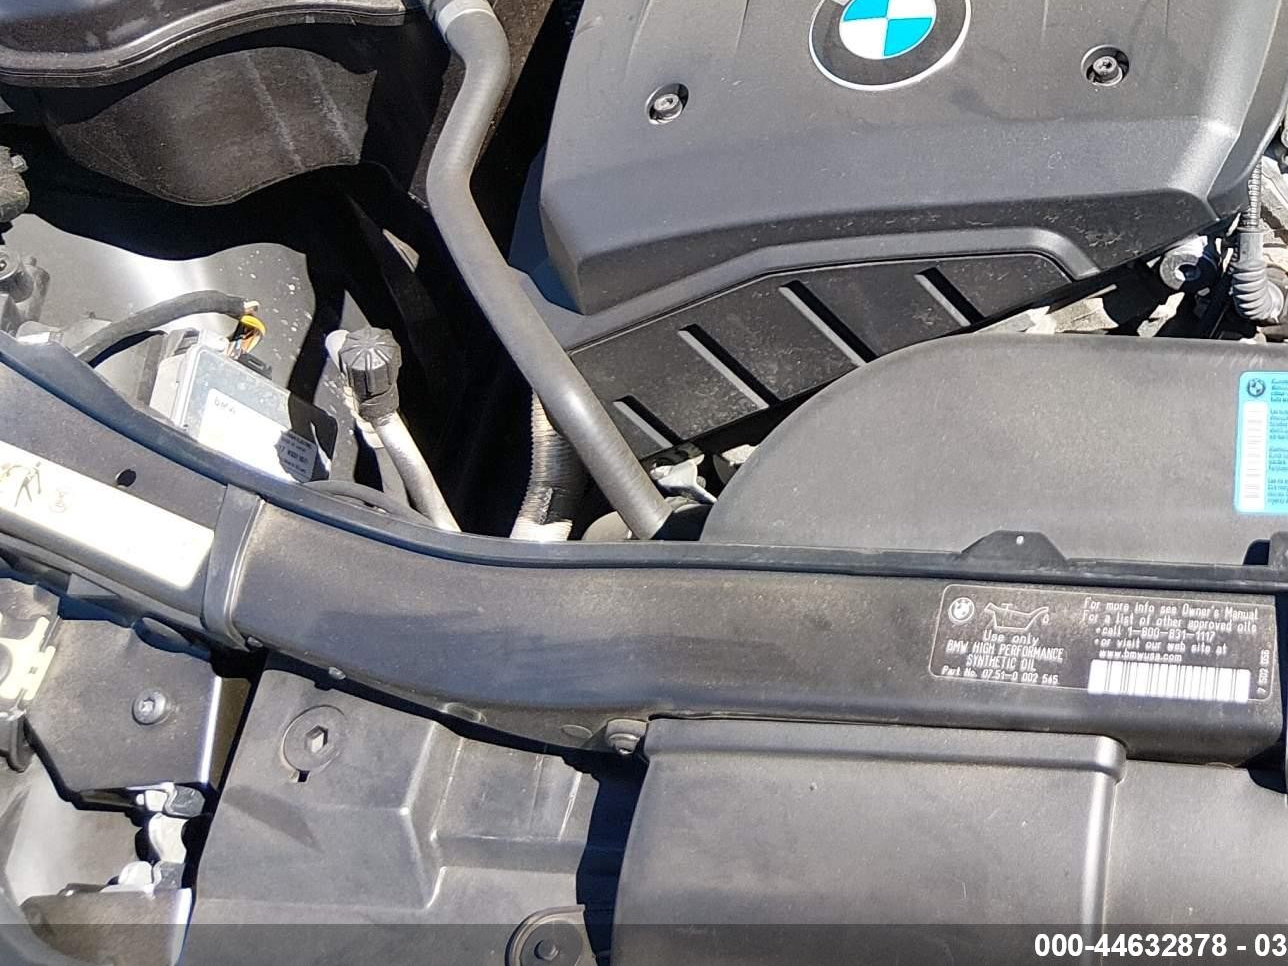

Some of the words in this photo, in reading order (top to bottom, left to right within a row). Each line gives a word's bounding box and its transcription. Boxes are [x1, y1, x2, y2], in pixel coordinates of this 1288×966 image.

[1083, 597, 1101, 609] For
[1106, 602, 1129, 612] more
[1135, 601, 1155, 612] info
[1160, 605, 1177, 615] see
[1182, 603, 1220, 618] Owner's
[1224, 606, 1259, 621] Manual
[1081, 610, 1100, 622] For
[1104, 615, 1111, 624] a
[1116, 612, 1134, 624] list
[1139, 615, 1151, 626] of
[1156, 615, 1182, 627] other
[1188, 618, 1233, 633] approved
[1237, 620, 1257, 633] oils
[983, 630, 1005, 642] Use
[1012, 633, 1040, 647] only
[1117, 637, 1140, 649] visit
[1145, 640, 1162, 650] our
[1166, 640, 1186, 652] web
[1191, 643, 1211, 655] site
[1216, 644, 1228, 656] at
[946, 639, 969, 654] BMW
[972, 642, 995, 655] HIGH
[998, 644, 1065, 664] PERFORMANCE
[1099, 648, 1183, 663] www.bmwusa.com
[941, 665, 961, 677] Part
[964, 667, 978, 678] No.
[966, 654, 1018, 669] SYNTHETIC
[1020, 659, 1037, 672] OIL
